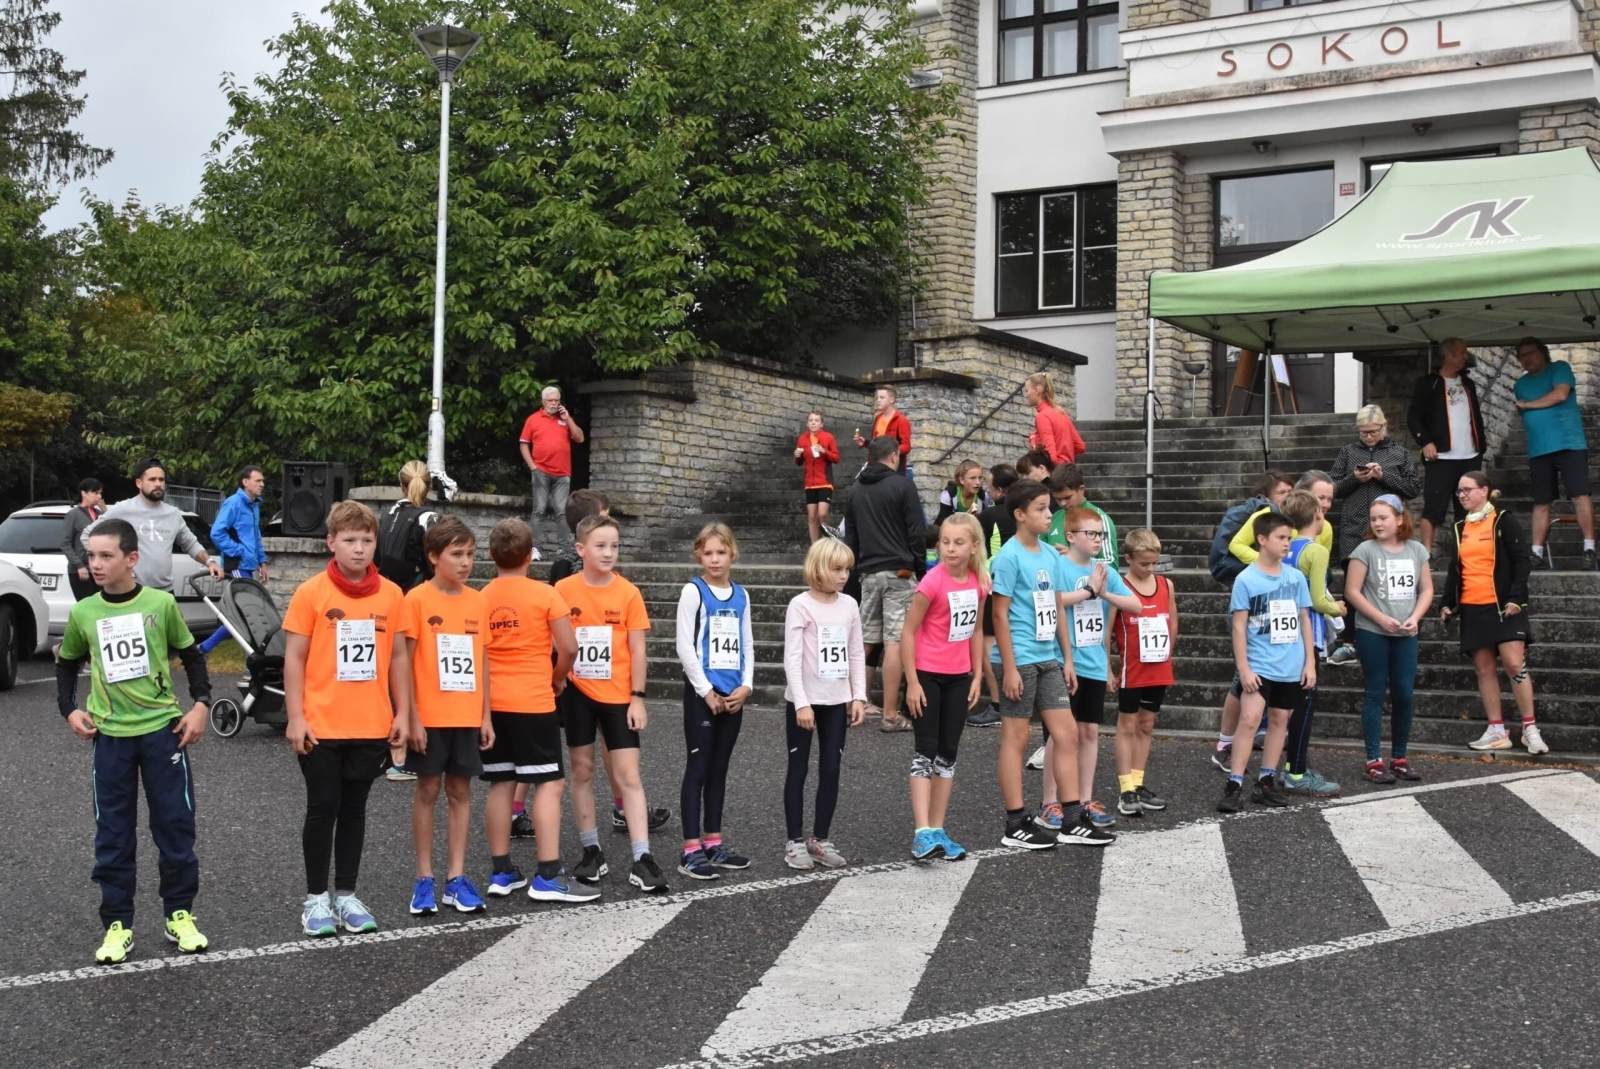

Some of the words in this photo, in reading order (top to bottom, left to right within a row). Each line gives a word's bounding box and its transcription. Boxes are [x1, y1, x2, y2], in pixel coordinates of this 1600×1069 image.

[1217, 20, 1461, 77] SOKOL
[1399, 195, 1534, 242] SK
[1376, 234, 1543, 249] www.sportklub.cz
[1389, 575, 1414, 588] 143
[953, 609, 977, 627] 122
[1076, 618, 1103, 633] 145
[1272, 617, 1298, 631] 150
[103, 637, 146, 662] 105
[711, 637, 739, 654] 144
[1141, 634, 1168, 648] 117
[339, 644, 375, 663] 127
[578, 646, 611, 662] 104
[820, 646, 847, 663] 151
[440, 656, 474, 675] 152
